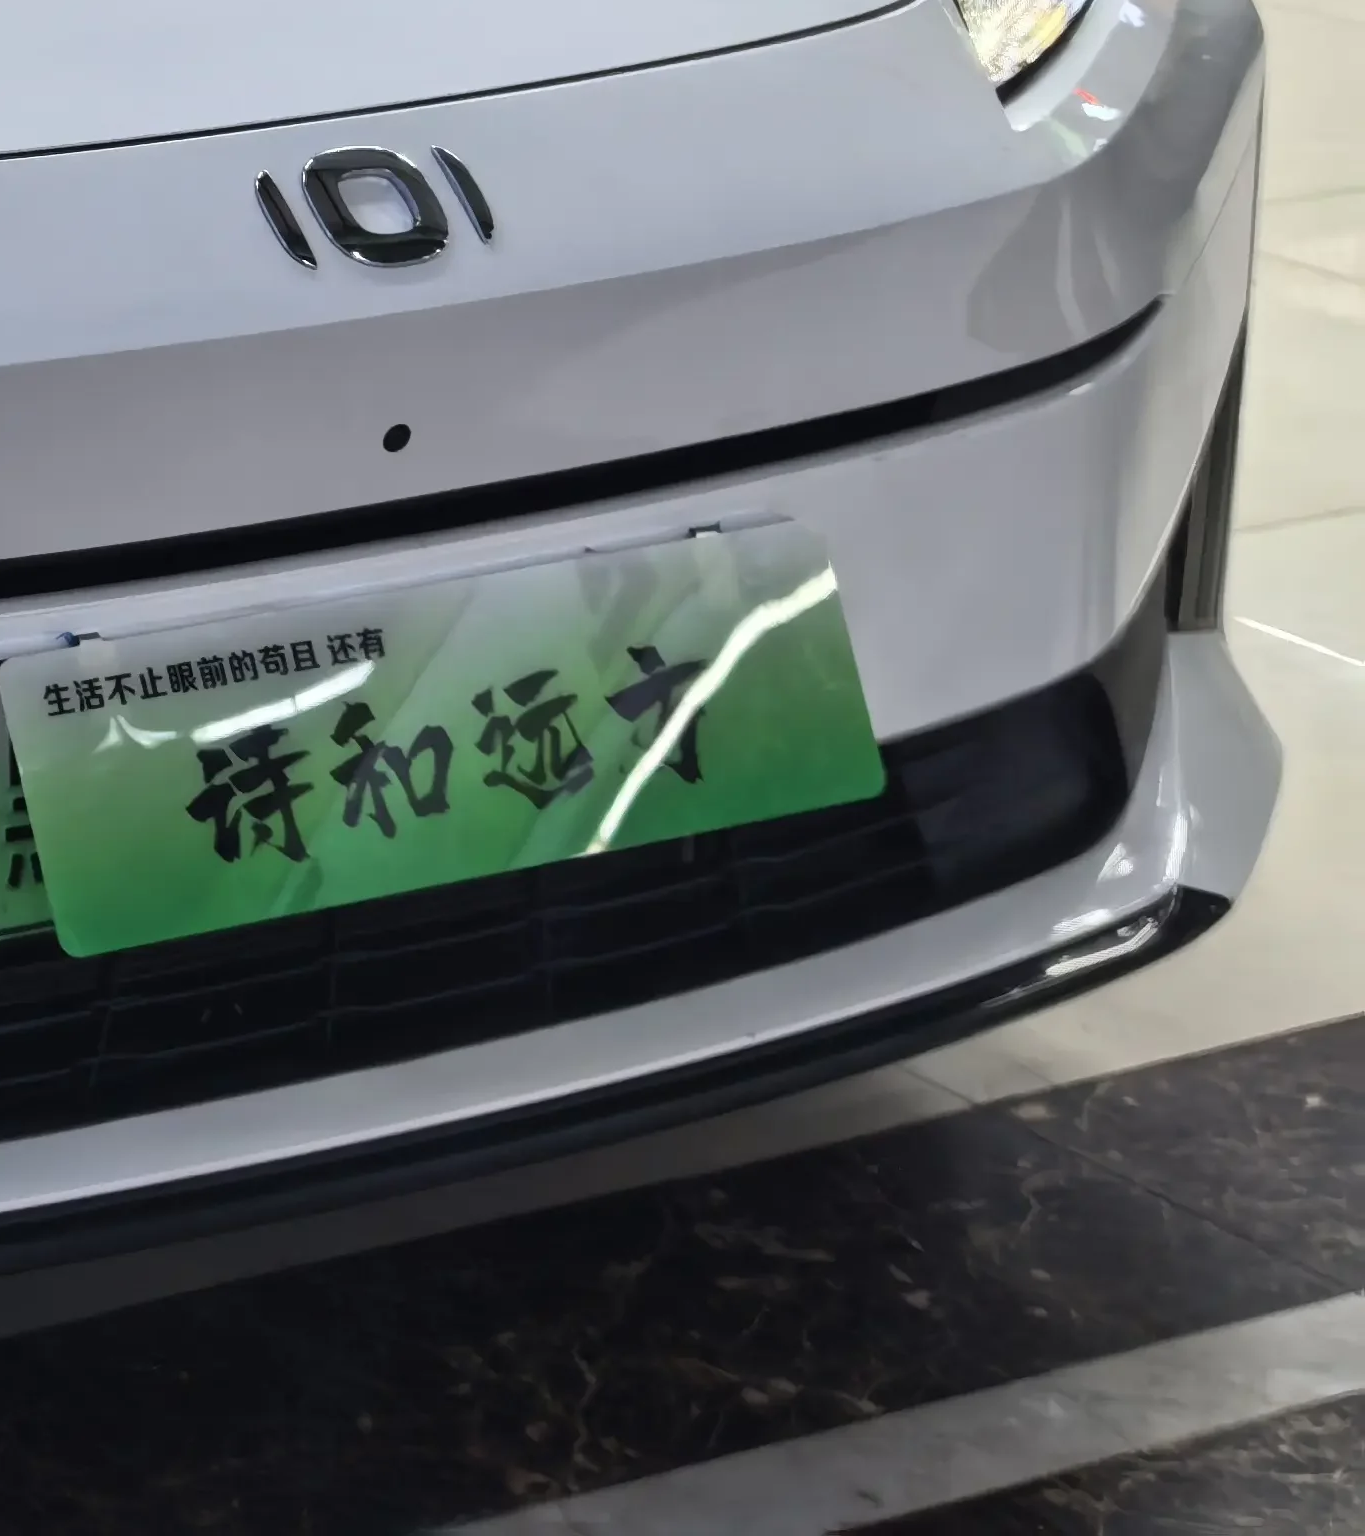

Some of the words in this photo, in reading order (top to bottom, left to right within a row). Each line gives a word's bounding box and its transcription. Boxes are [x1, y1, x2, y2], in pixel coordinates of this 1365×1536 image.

[43, 640, 321, 717] 生活不止眼前的苟且
[326, 627, 387, 667] 还有
[185, 644, 709, 864] 诗和远方
